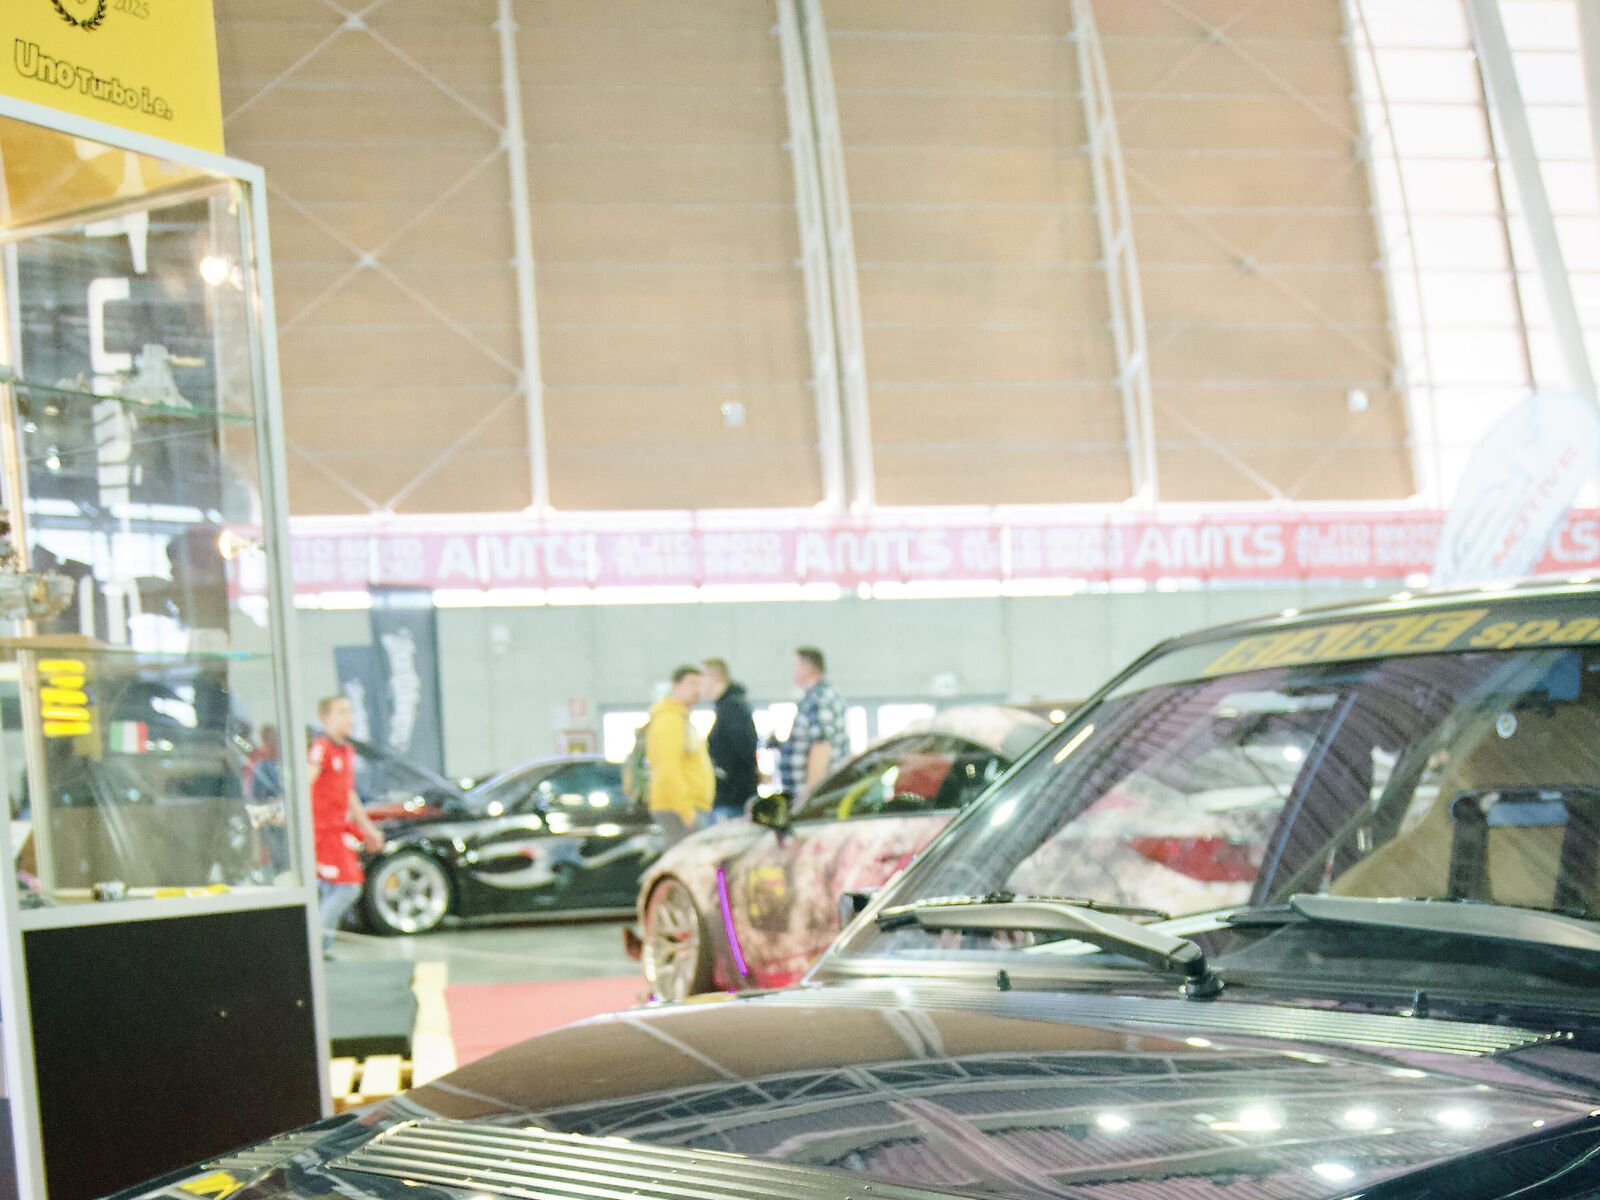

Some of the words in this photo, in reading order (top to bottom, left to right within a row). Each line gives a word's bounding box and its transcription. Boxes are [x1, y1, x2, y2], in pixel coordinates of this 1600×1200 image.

[14, 38, 76, 89] Uno
[76, 66, 139, 108] Turbo
[1134, 525, 1283, 568] AMTS
